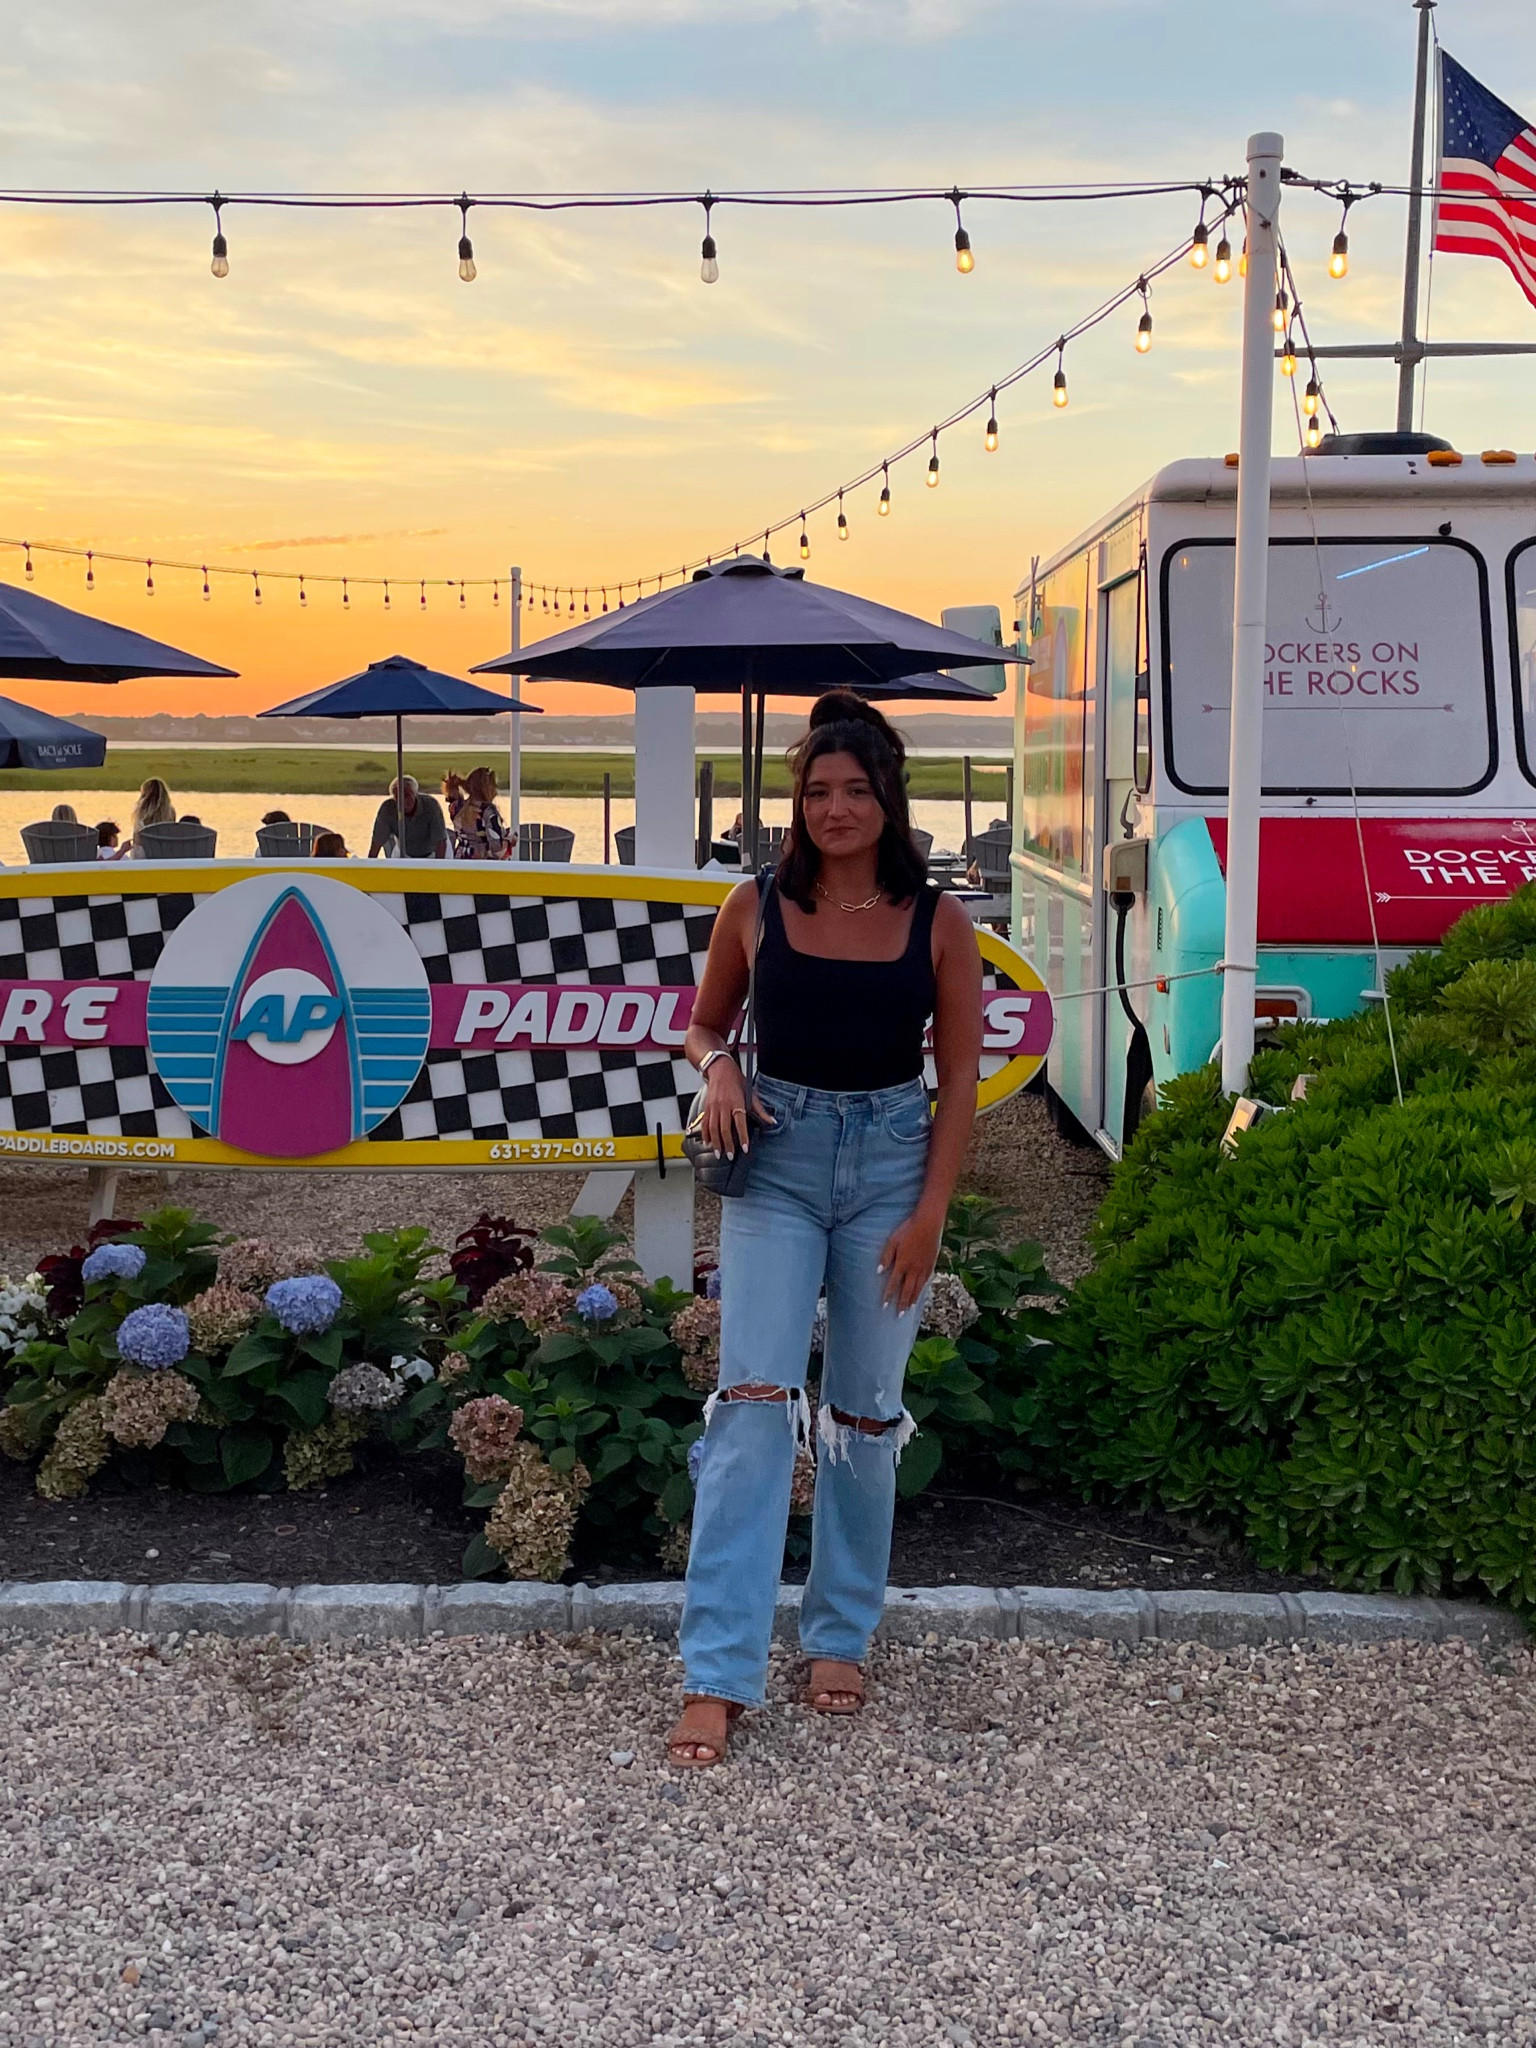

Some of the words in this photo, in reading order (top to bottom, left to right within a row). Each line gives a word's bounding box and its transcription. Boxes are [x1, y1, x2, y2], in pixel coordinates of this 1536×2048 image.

[1264, 642, 1362, 664] OCKERS
[1371, 642, 1419, 663] ON
[1263, 671, 1294, 696] HE
[1307, 670, 1420, 696] ROCKS
[1409, 866, 1507, 885] THE
[230, 994, 344, 1043] AP
[489, 1141, 616, 1160] 631-377-0162
